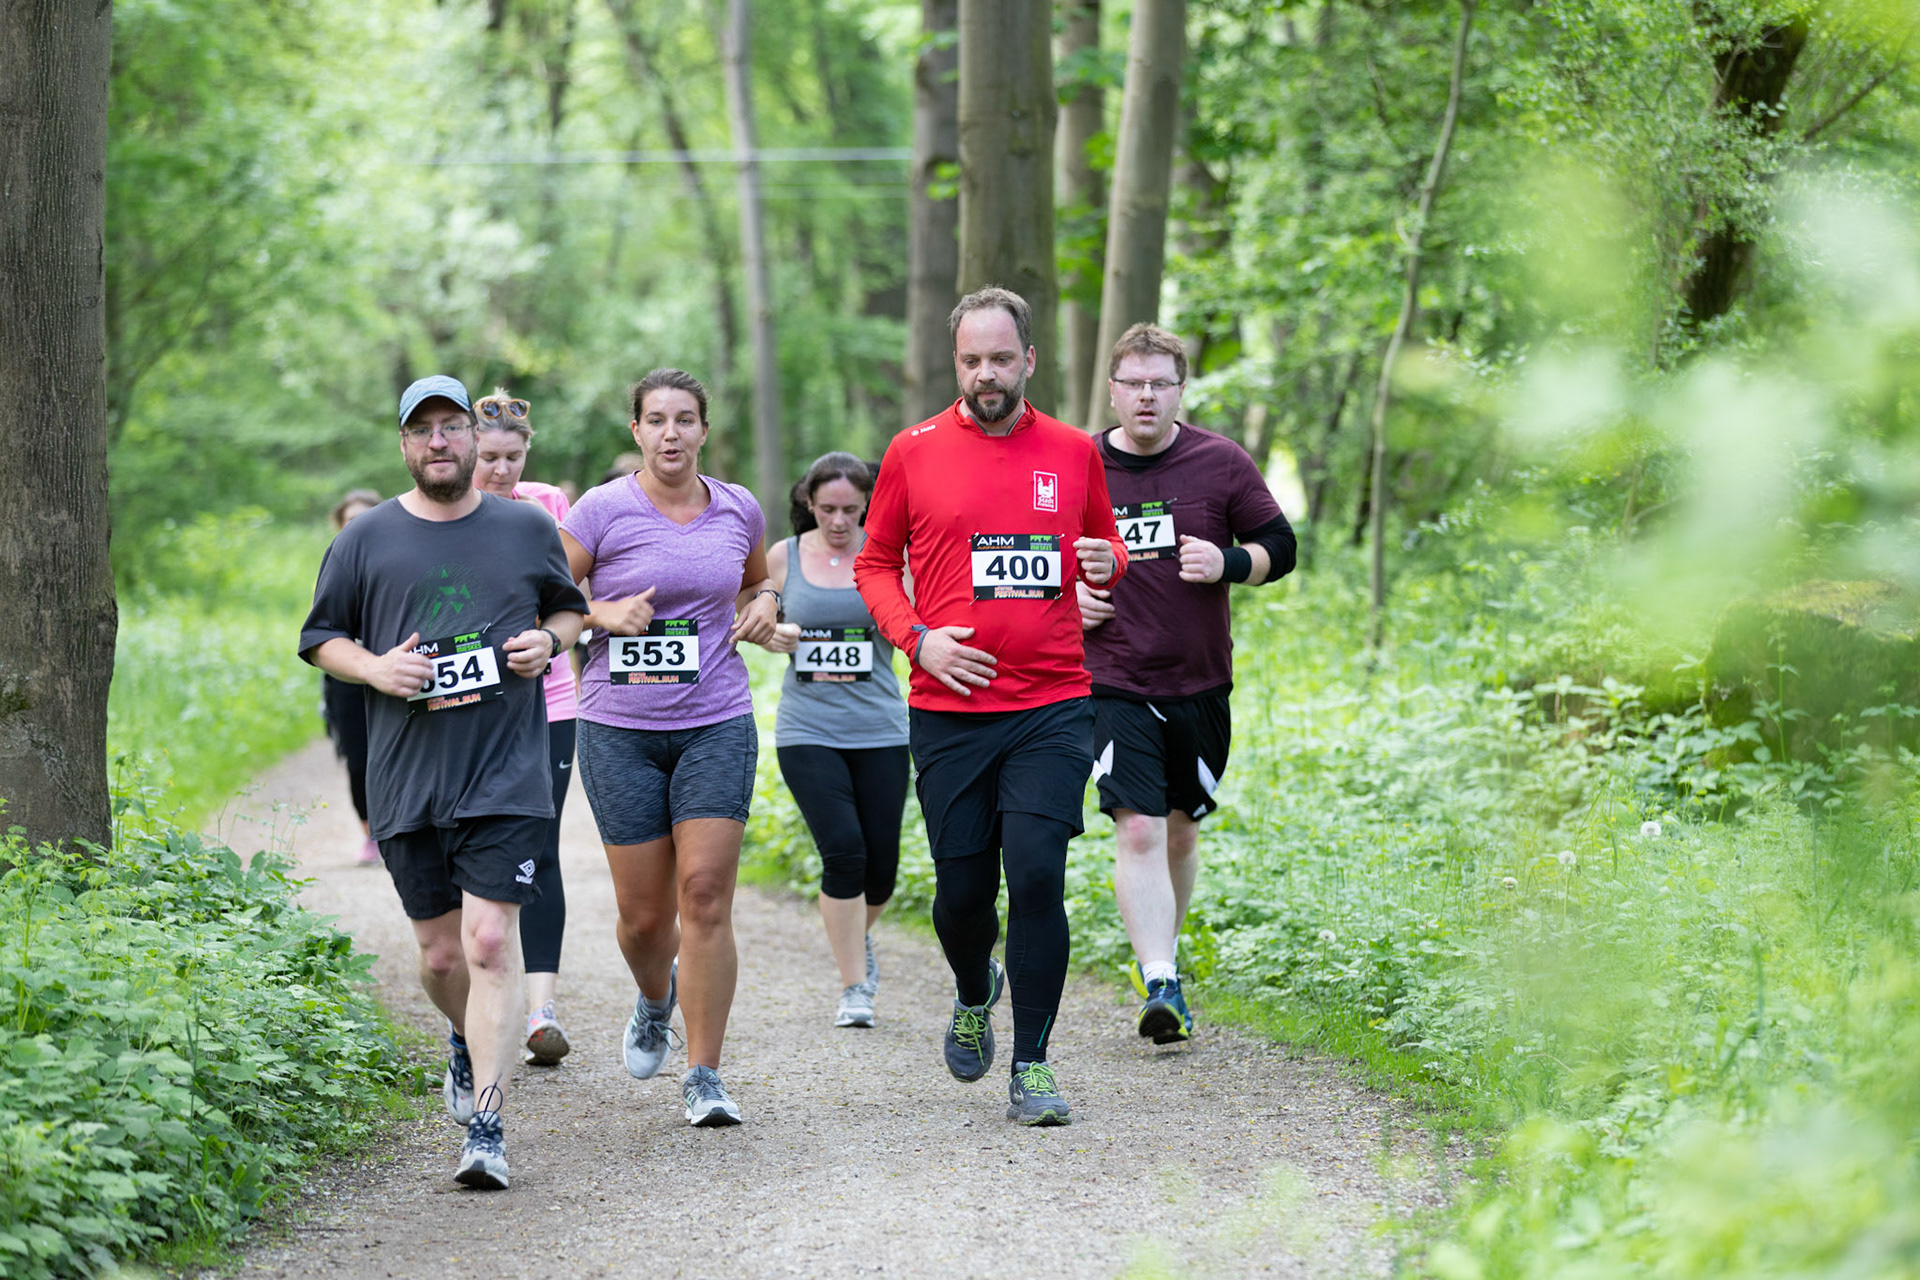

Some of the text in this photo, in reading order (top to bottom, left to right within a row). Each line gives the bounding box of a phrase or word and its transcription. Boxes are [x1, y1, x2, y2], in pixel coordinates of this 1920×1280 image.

[977, 536, 1015, 546] AHM
[1115, 521, 1161, 545] 47
[985, 555, 1049, 581] 400
[800, 629, 832, 638] AHM
[621, 641, 686, 667] 553
[807, 646, 861, 667] 448
